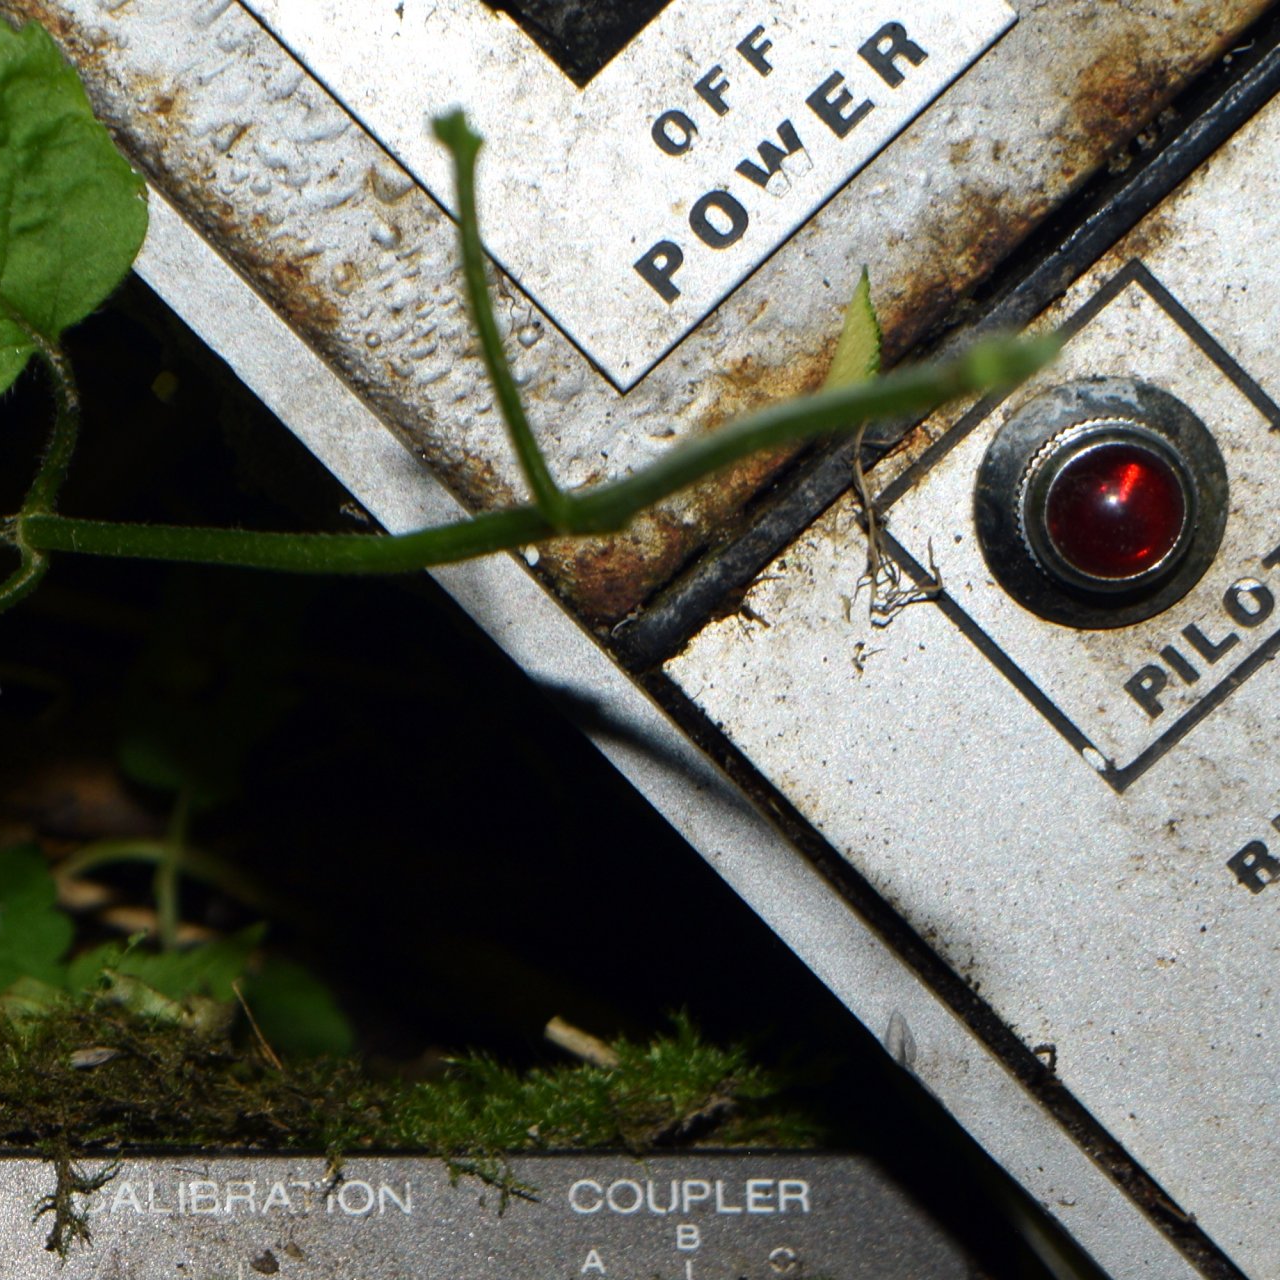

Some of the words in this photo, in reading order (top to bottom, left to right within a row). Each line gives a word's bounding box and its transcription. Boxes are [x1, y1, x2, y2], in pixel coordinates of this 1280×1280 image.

[651, 24, 774, 157] OFF
[633, 21, 929, 305] POWER
[1123, 544, 1280, 720] PILO
[568, 1178, 811, 1214] COUPLER
[676, 1224, 701, 1250] B
[580, 1249, 606, 1274] A
